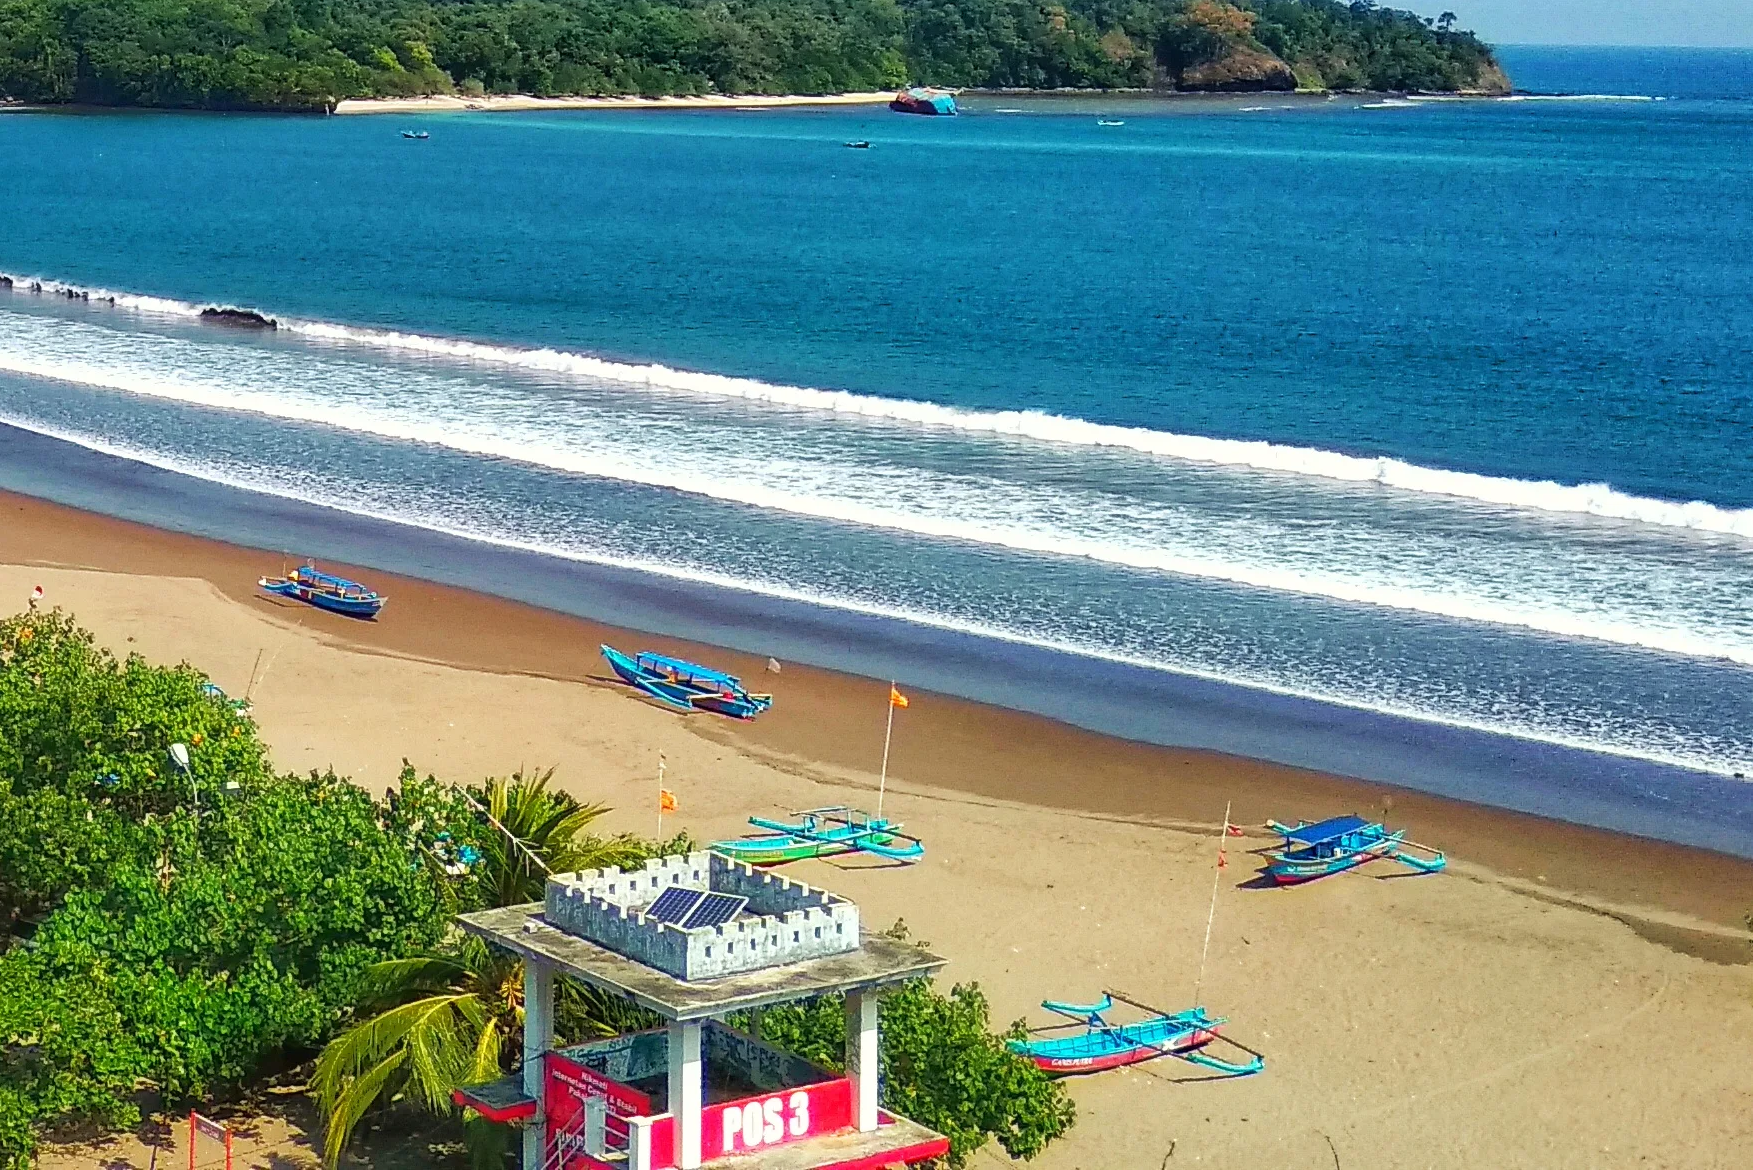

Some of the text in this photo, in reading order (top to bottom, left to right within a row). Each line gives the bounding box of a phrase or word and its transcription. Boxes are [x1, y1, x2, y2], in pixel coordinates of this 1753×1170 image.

[582, 1072, 608, 1090] Nikmati
[723, 1091, 810, 1151] POS 3
